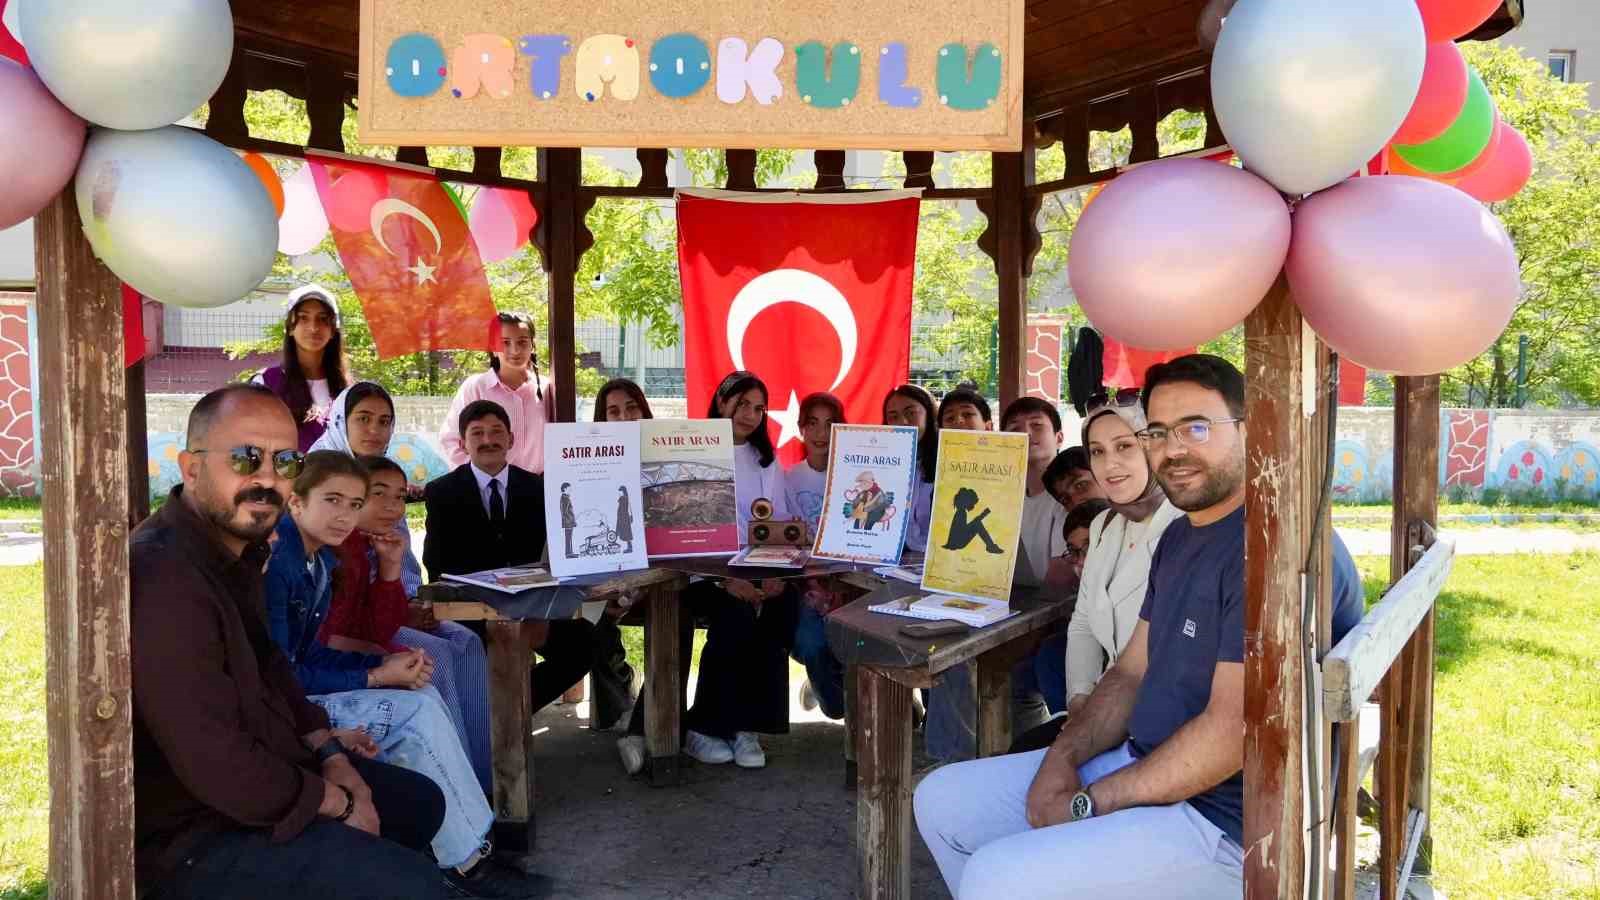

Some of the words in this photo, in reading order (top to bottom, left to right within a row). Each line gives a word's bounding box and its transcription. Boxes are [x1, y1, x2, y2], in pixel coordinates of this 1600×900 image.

[385, 32, 1002, 110] ORTAOKULU
[651, 436, 685, 447] SATIR
[688, 435, 720, 446] ARASI
[562, 446, 592, 459] SATIR
[594, 445, 625, 458] ARASI
[843, 454, 871, 465] SATIR
[872, 455, 902, 466] ARASI
[950, 461, 978, 473] SATIR
[981, 463, 1013, 476] ARASI
